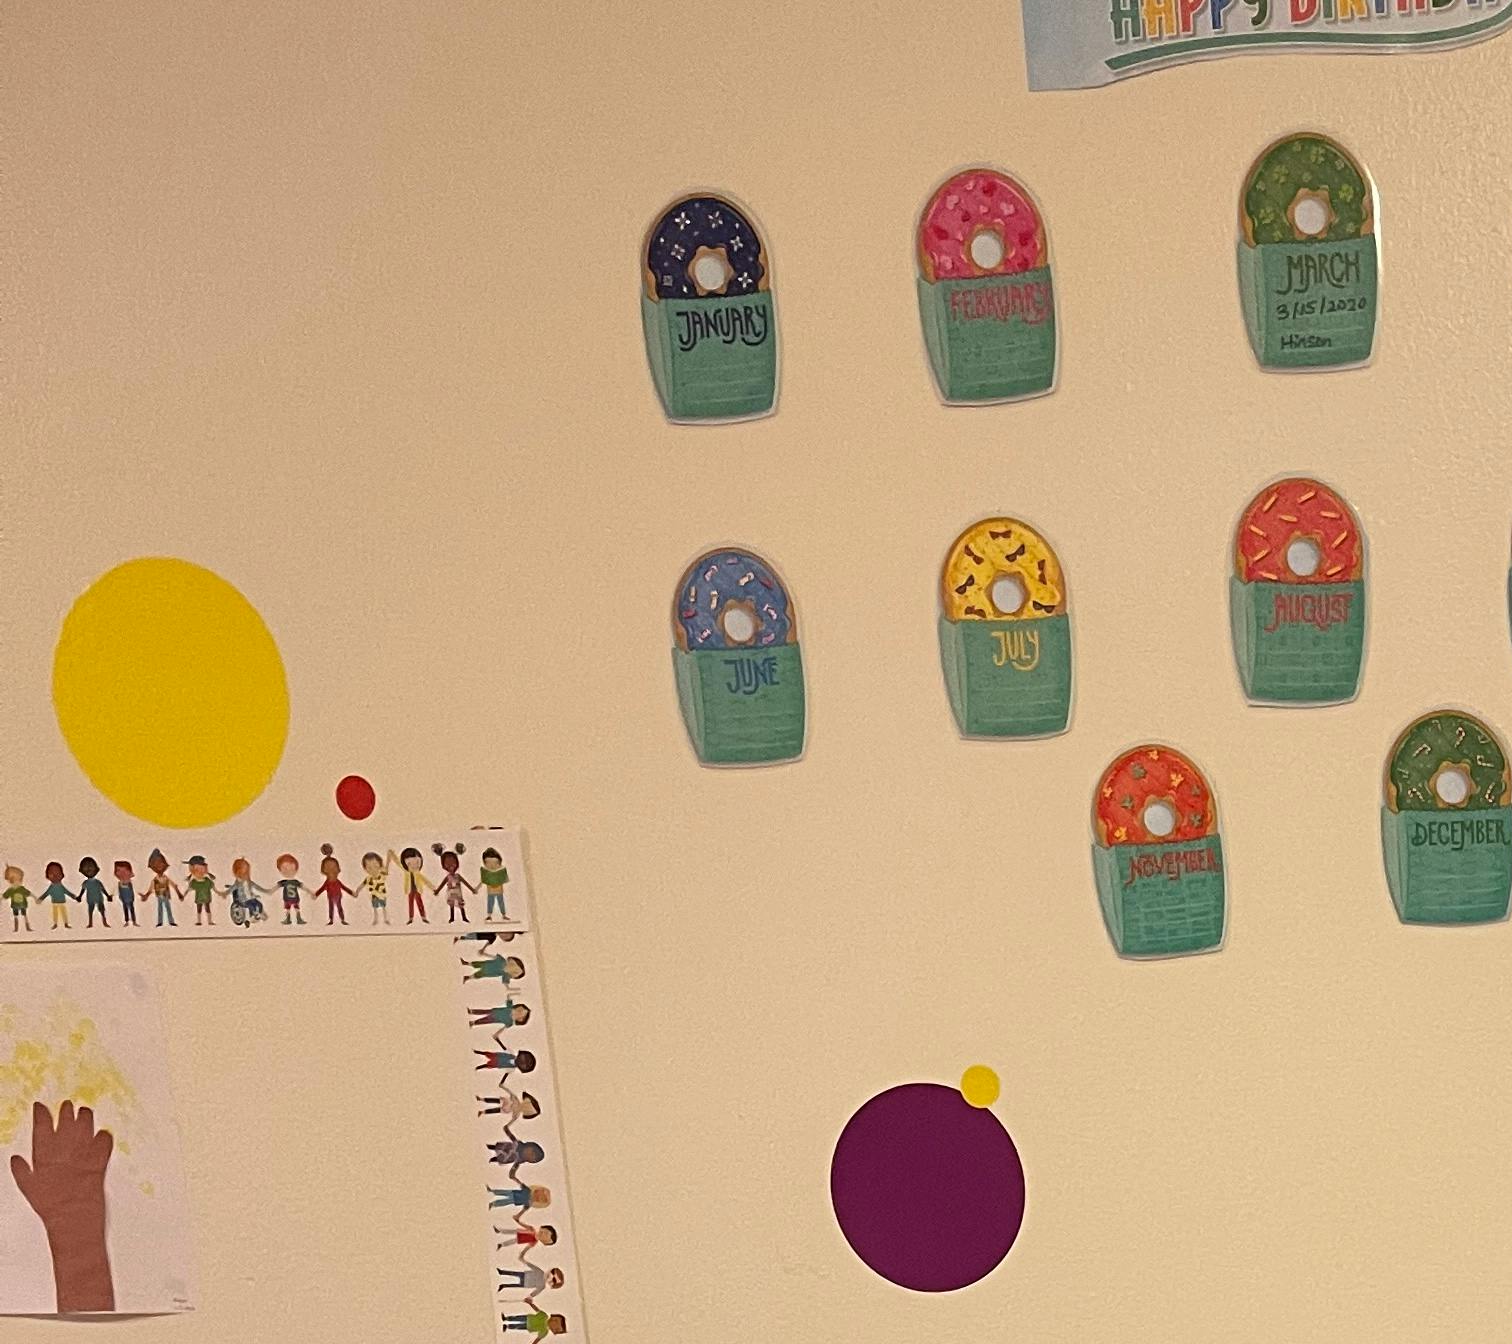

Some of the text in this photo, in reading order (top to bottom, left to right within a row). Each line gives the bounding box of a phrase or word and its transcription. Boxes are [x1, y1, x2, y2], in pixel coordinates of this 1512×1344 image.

[1275, 251, 1361, 295] MARCH
[951, 283, 1053, 326] FEBRUARY
[1276, 296, 1368, 320] 3/15/2020
[676, 303, 768, 352] JANUARY
[1263, 591, 1354, 634] AUGUST
[991, 629, 1040, 672] JULY
[723, 656, 780, 696] JUNE
[1411, 818, 1512, 851] DECEMBER
[1124, 847, 1223, 888] NOVEMBER
